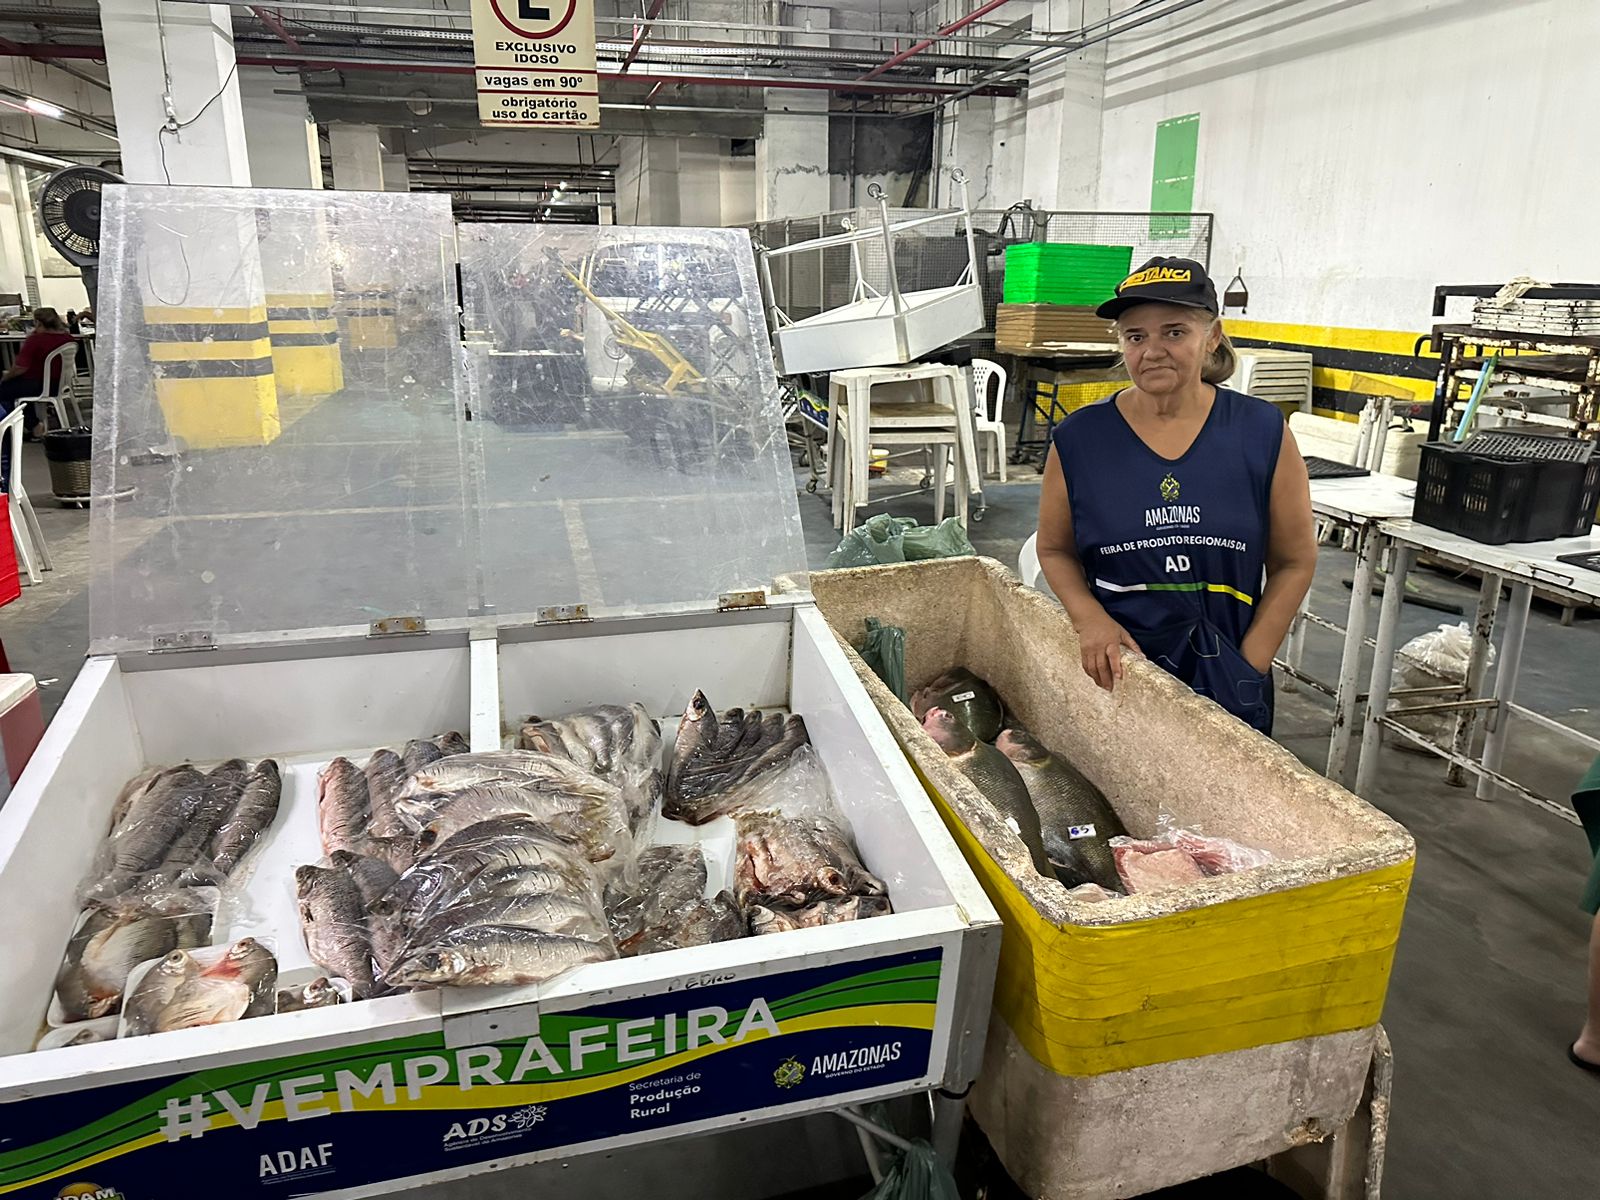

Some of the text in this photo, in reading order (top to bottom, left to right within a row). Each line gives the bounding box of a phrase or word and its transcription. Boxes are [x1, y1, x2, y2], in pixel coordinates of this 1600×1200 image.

[495, 41, 577, 54] EXCLUSIVO
[514, 53, 559, 64] IDOSO
[484, 75, 529, 88] vagas
[533, 77, 555, 88] em
[501, 97, 577, 110] obrigatório
[492, 109, 588, 120] uso do cartão
[1145, 505, 1200, 527] AMAZONAS
[1100, 544, 1123, 555] FEIRA
[1123, 542, 1136, 551] DE
[811, 1041, 902, 1076] AMAZONAS
[158, 996, 782, 1143] #VEMPRAFEIRA
[628, 1071, 702, 1091] Secretaria de
[630, 1085, 702, 1105] Produção
[630, 1102, 671, 1119] Rural
[442, 1114, 507, 1142] ADS
[259, 1142, 334, 1178] ADAF
